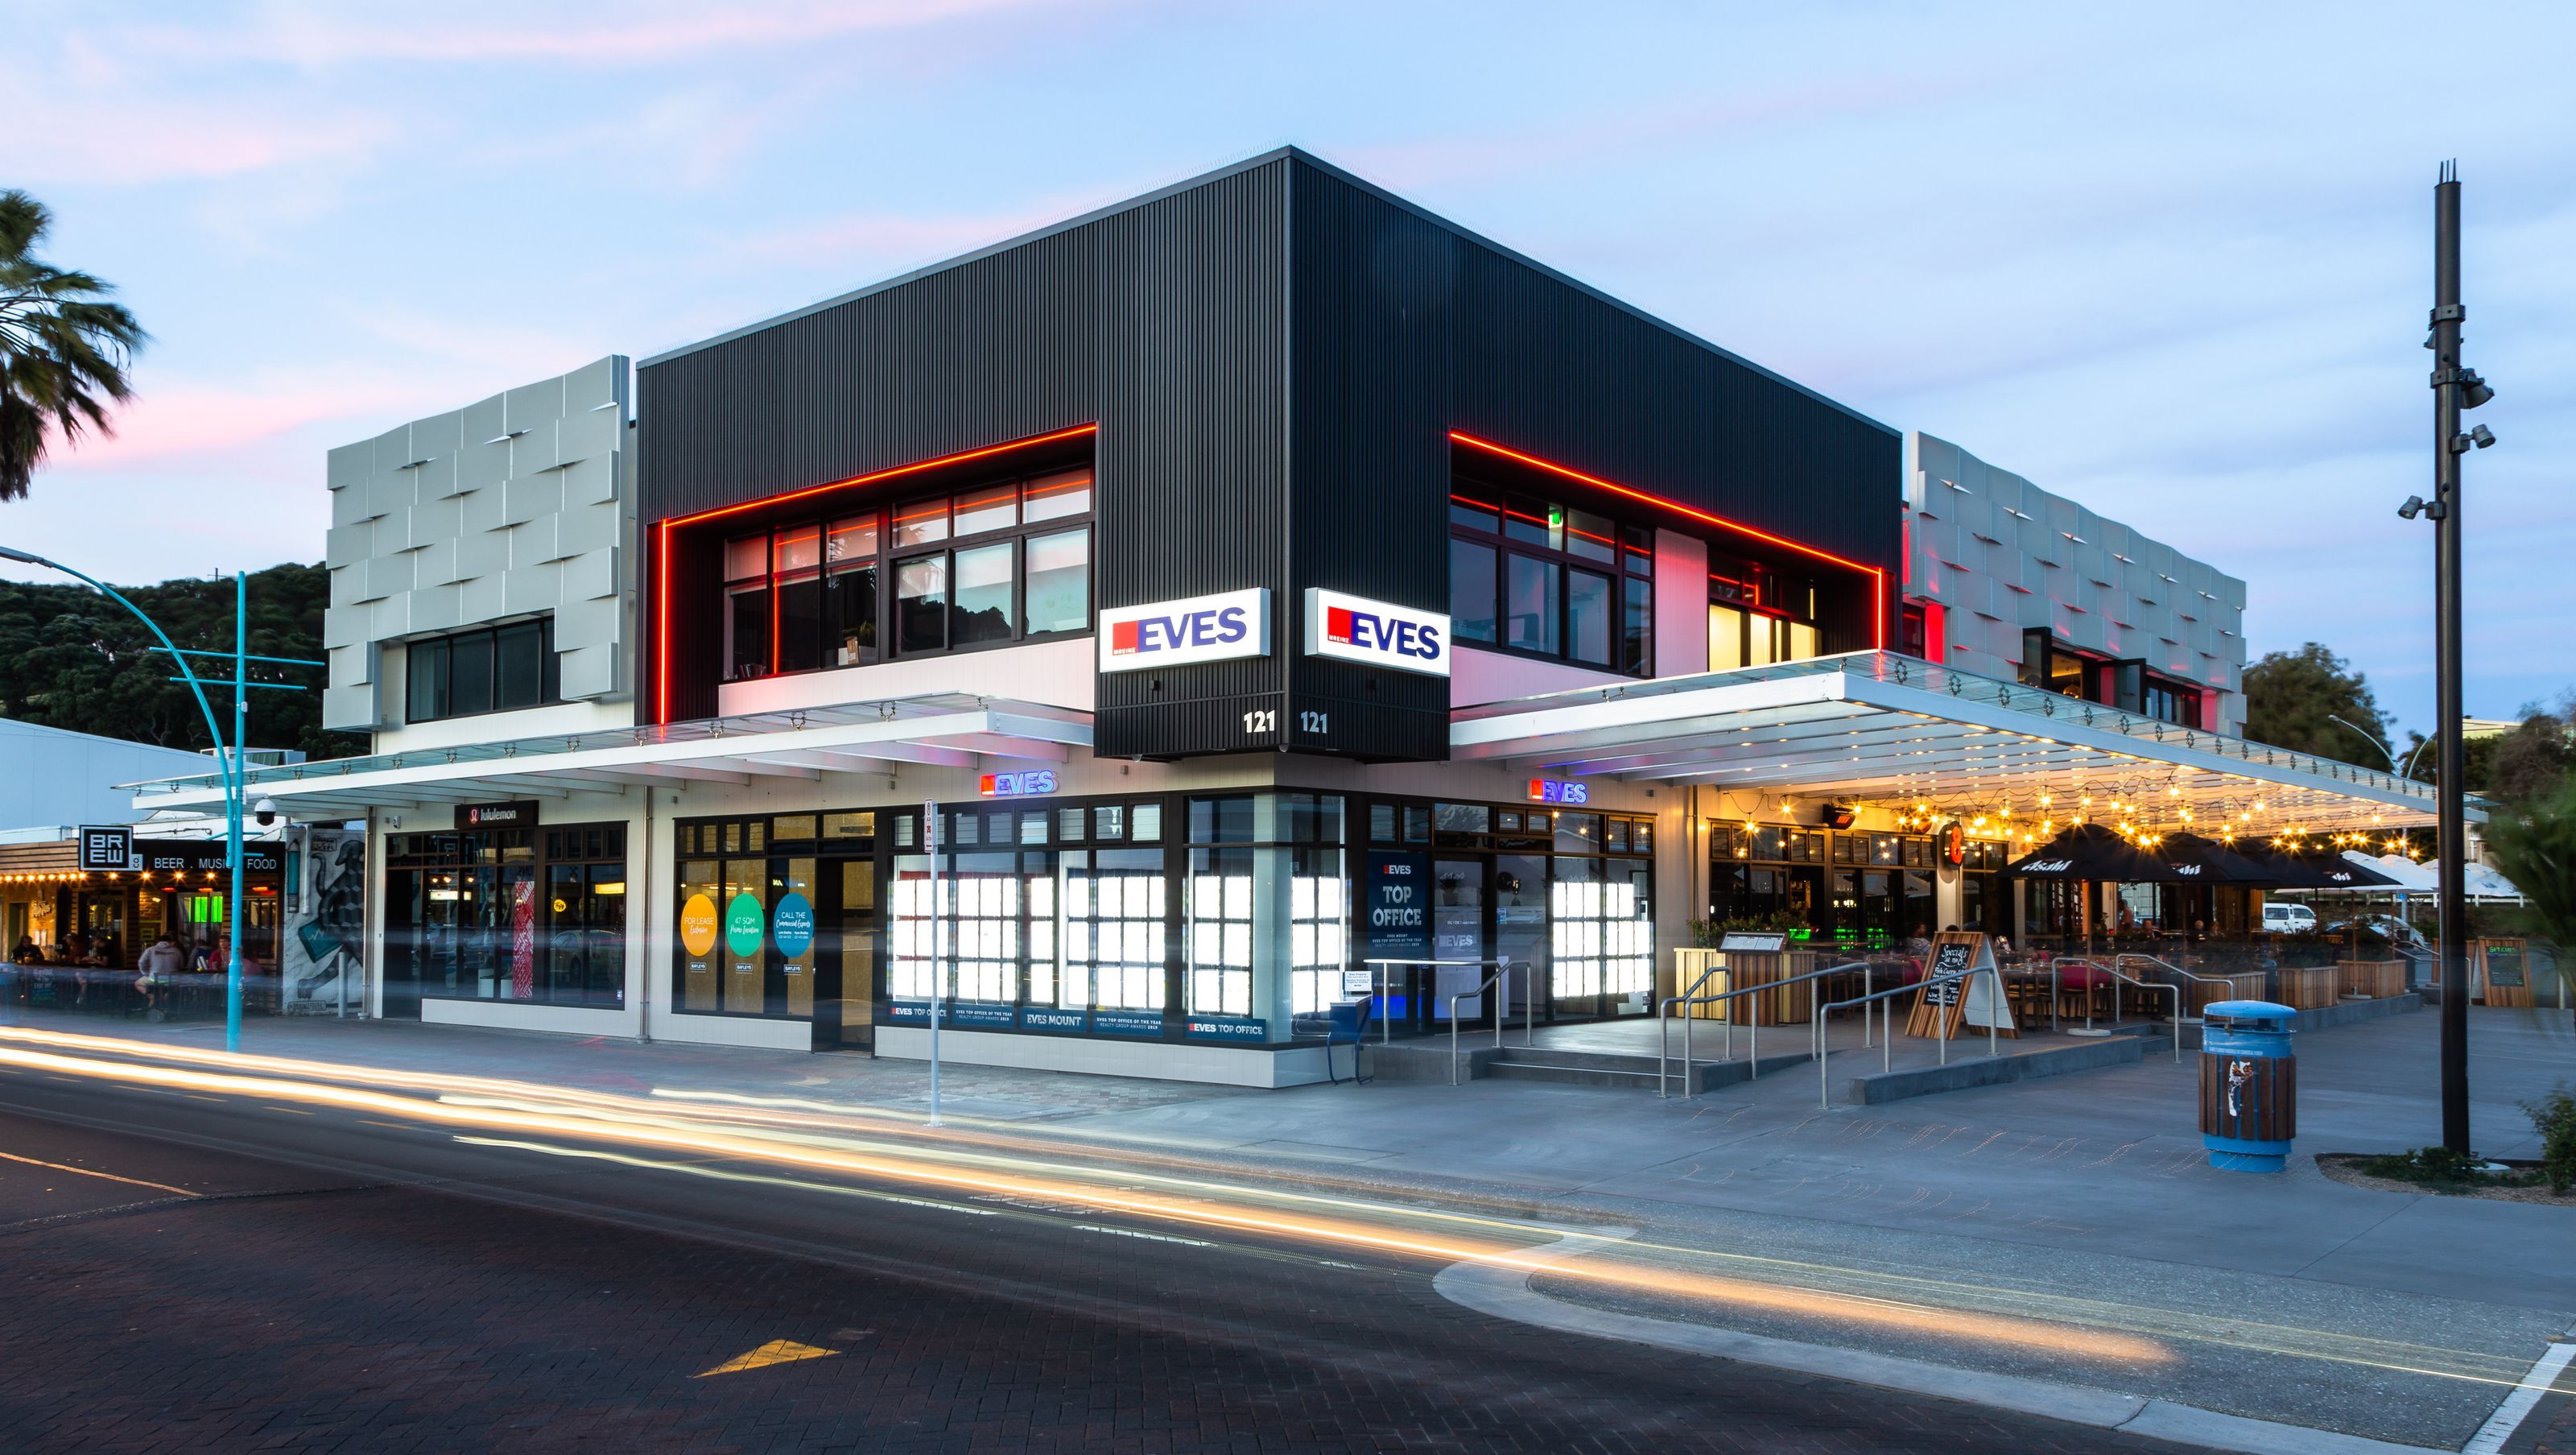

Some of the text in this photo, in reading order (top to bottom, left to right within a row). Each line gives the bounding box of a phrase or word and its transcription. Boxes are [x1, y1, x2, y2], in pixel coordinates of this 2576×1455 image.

[1138, 607, 1247, 653] EVES
[1352, 610, 1440, 660] EVES
[1328, 634, 1350, 643] MREINZ
[1244, 709, 1275, 734] 121
[1300, 710, 1327, 734] 121
[995, 770, 1055, 796] EVES
[1543, 780, 1587, 804] EVES
[481, 808, 517, 821] lululemon
[155, 858, 277, 870] BEER MUSI FOOD
[1389, 865, 1411, 874] EVES
[2021, 860, 2073, 871] Asahi
[1383, 885, 1412, 903] TOP
[696, 917, 714, 925] LEASE
[742, 916, 755, 924] SQM
[1373, 907, 1422, 927] OFFICE
[1448, 934, 1473, 947] EVES
[1941, 945, 1968, 959] Specials
[895, 1007, 913, 1015] EVES
[914, 1008, 926, 1016] TOP
[1026, 1014, 1082, 1026] EVES MOUNT
[1194, 1023, 1263, 1035] EVES TOP OFFICE
